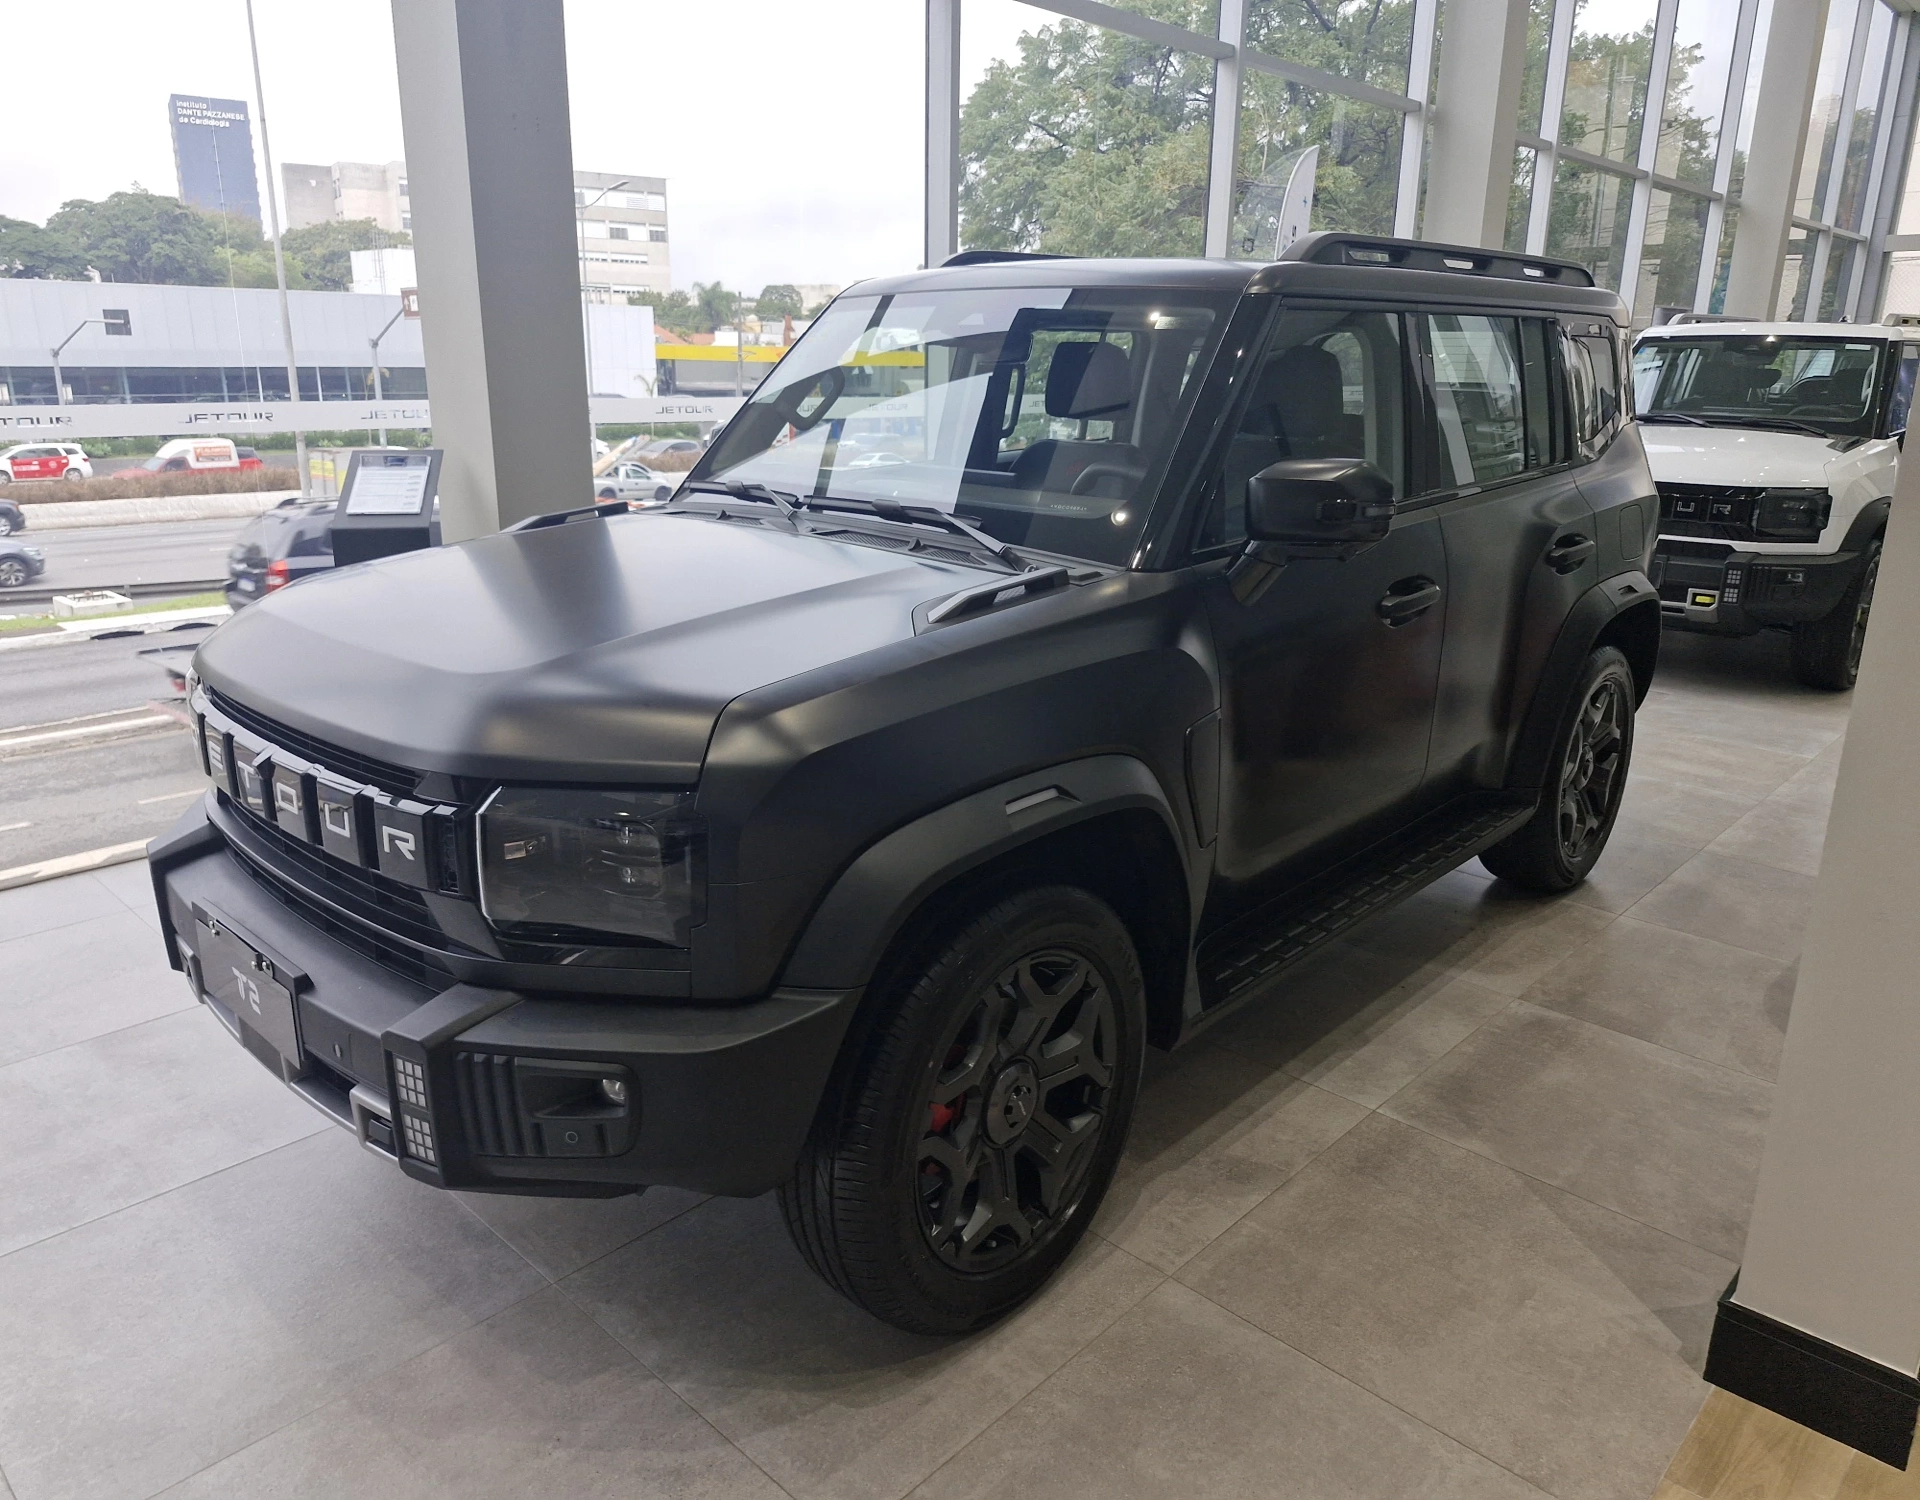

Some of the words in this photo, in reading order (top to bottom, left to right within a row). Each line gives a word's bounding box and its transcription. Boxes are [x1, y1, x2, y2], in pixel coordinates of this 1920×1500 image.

[176, 100, 207, 109] Instituto
[177, 107, 202, 117] DANTE
[202, 110, 246, 121] PAZZANESE
[179, 116, 189, 124] de
[189, 117, 230, 128] Cardiologia
[361, 409, 429, 420] JETOU
[655, 405, 714, 415] JETOUR
[0, 416, 73, 429] TOUR
[178, 412, 274, 424] JETOUR
[1677, 501, 1732, 515] UR
[232, 967, 262, 1016] T2
